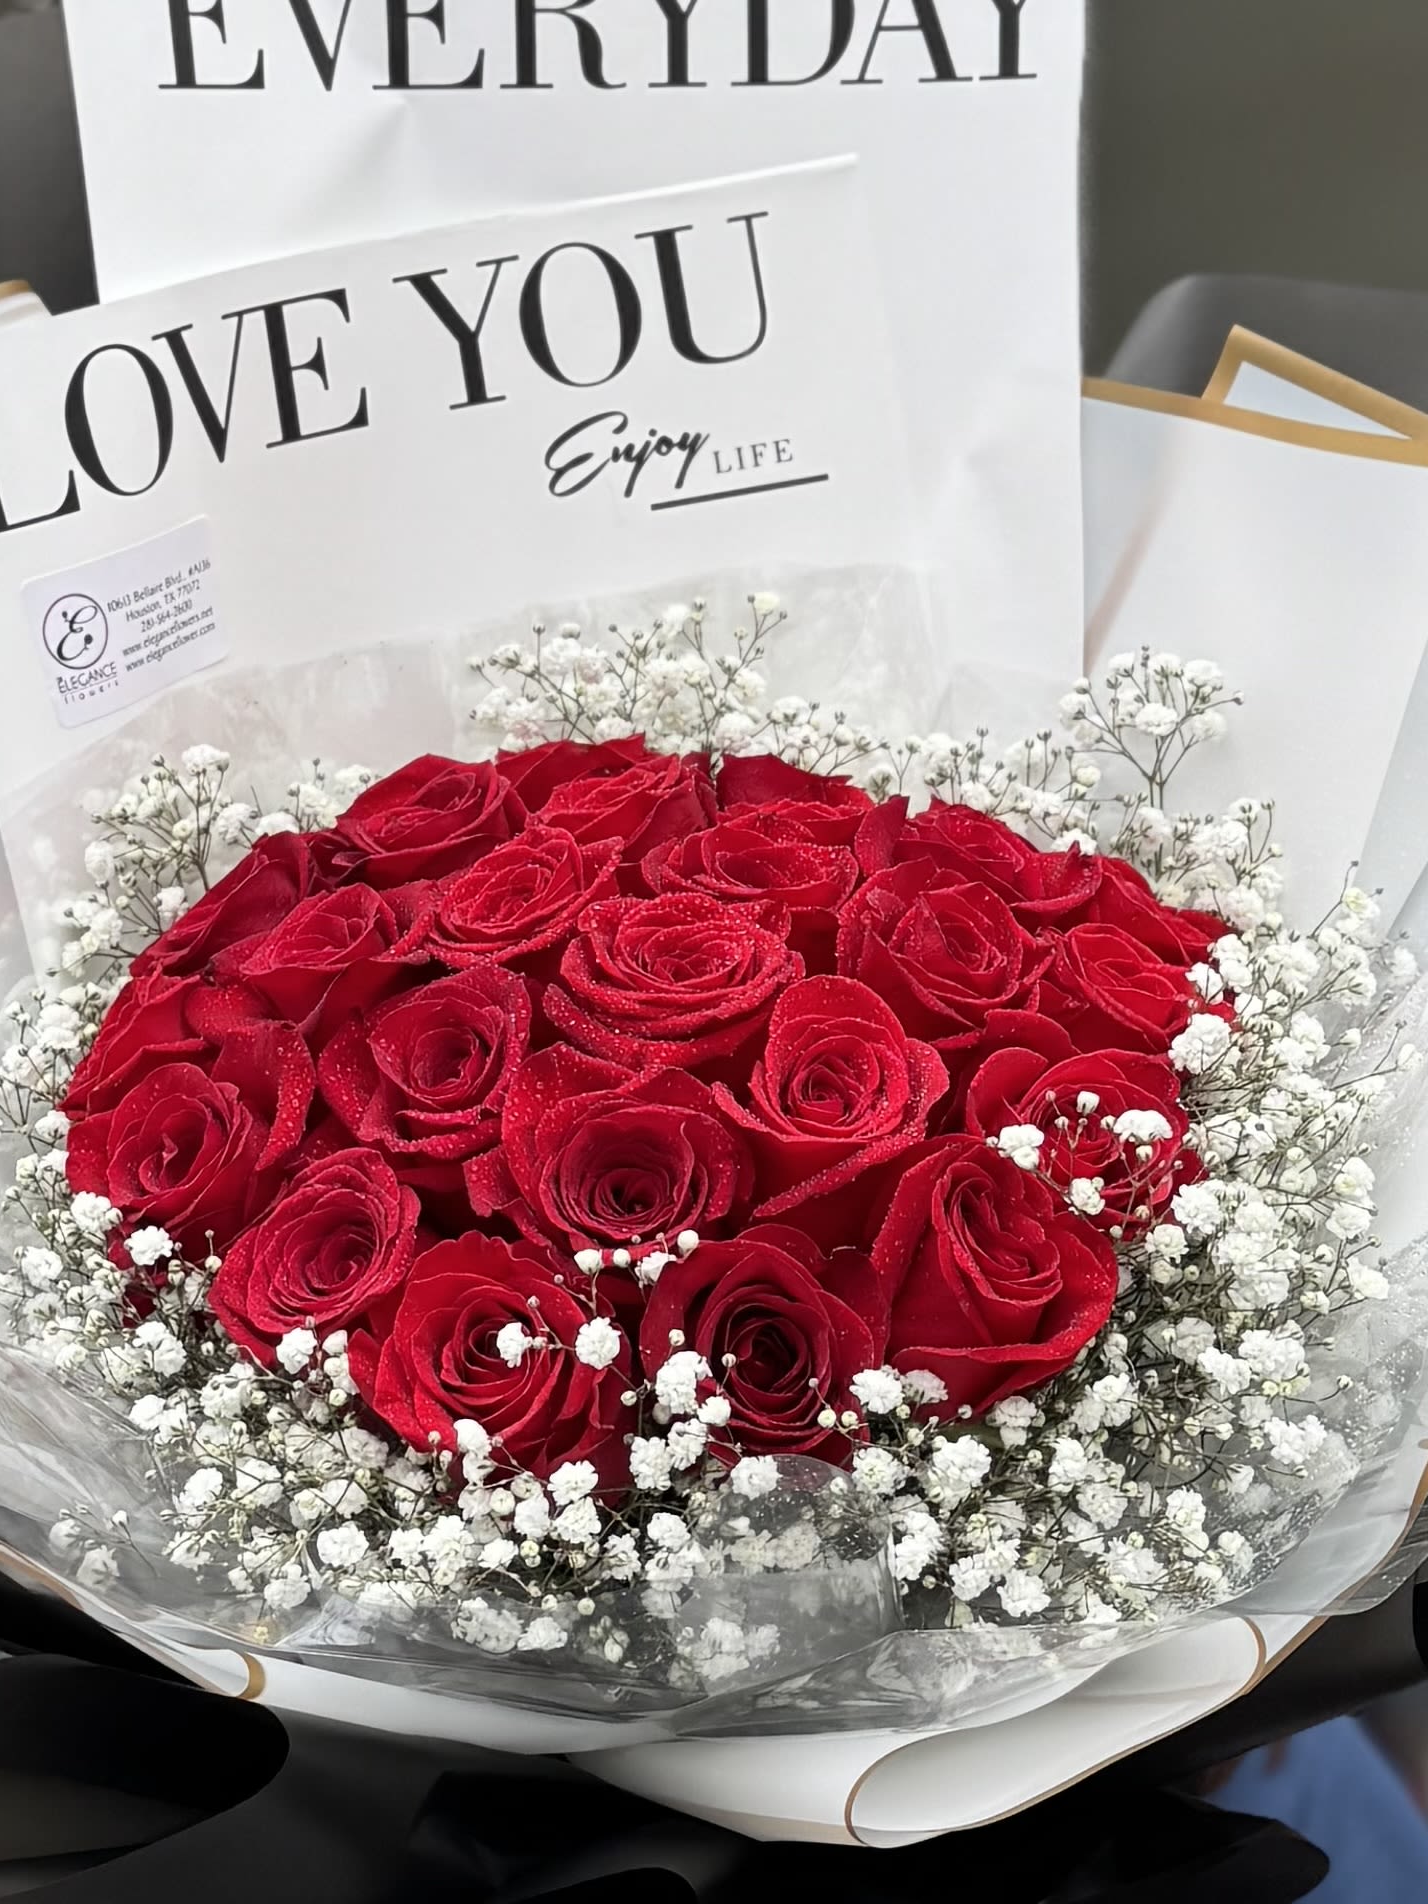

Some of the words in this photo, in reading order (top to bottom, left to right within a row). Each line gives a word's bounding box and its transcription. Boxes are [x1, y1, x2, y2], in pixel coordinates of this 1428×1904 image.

[393, 211, 769, 410] YOU
[544, 410, 710, 498] Enjoy
[713, 438, 794, 474] LIFE
[58, 661, 118, 694] ELEGANCE
